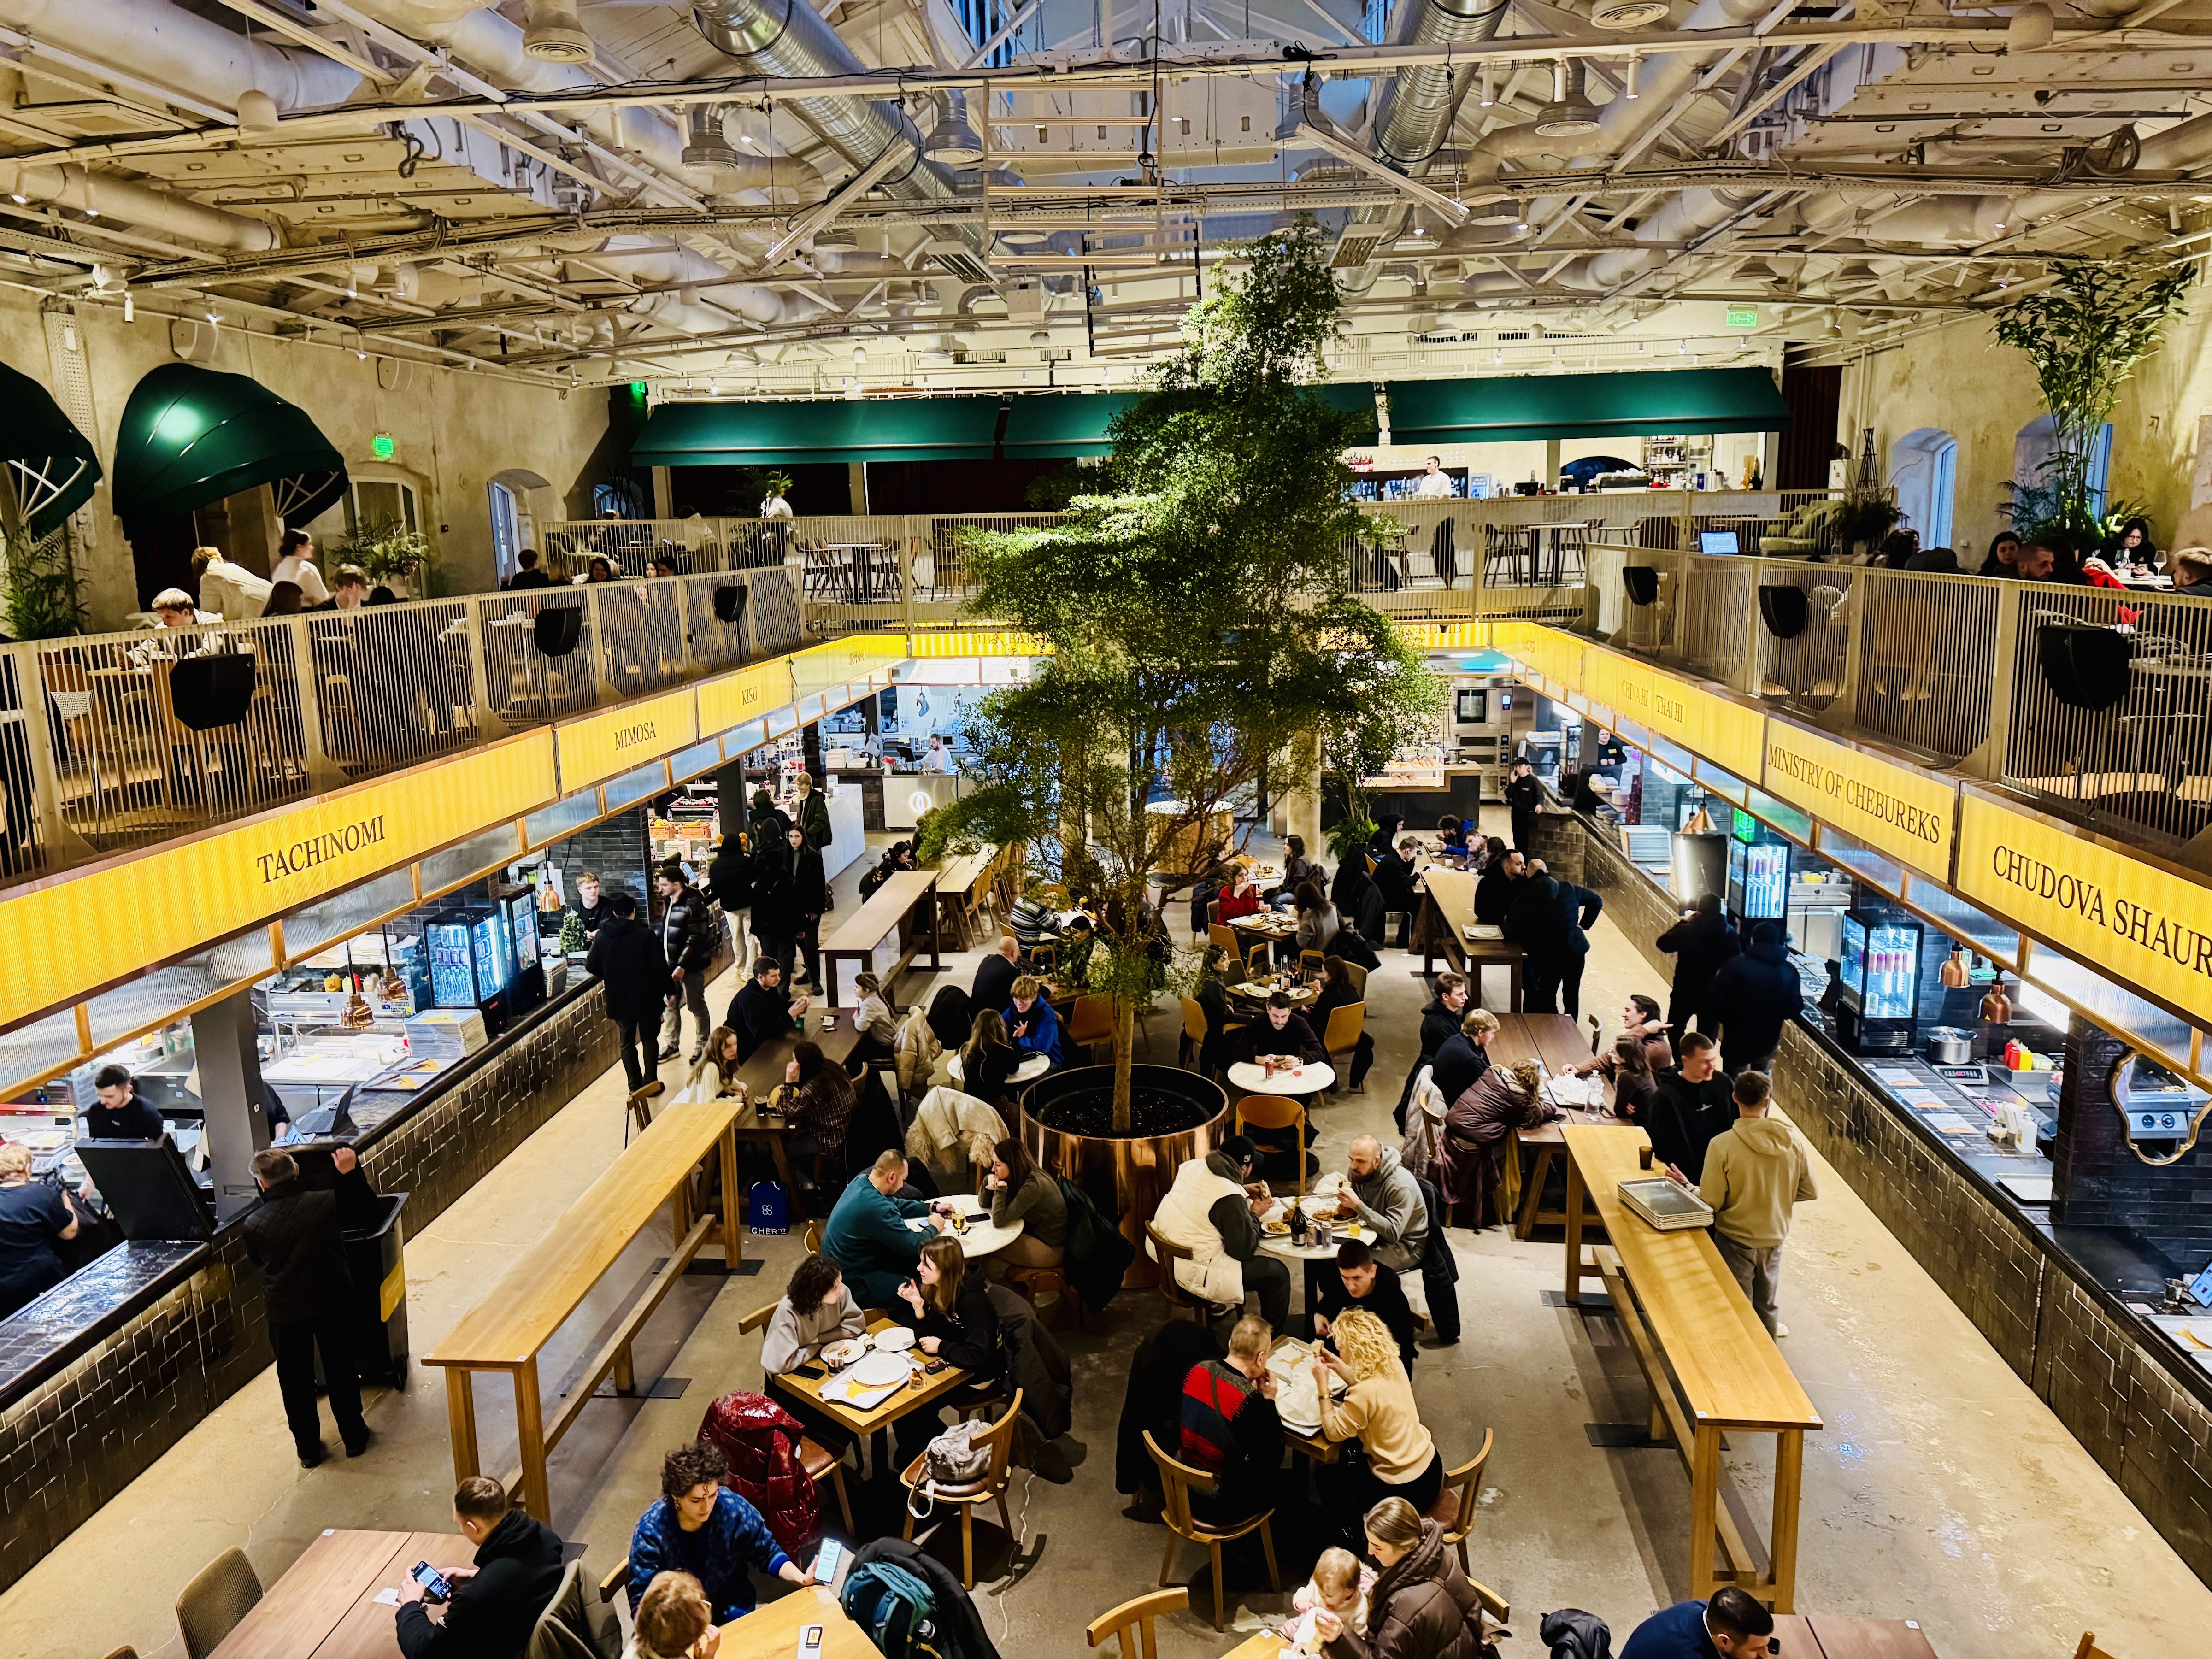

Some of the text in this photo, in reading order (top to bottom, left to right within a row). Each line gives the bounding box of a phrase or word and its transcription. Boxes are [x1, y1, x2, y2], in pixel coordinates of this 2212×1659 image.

[741, 686, 758, 705] KISU
[1622, 680, 1648, 707] CHINA HI
[1656, 695, 1683, 723] THAI HI
[614, 720, 656, 750] MIMOSA
[1768, 744, 1940, 844] MINISTRY OF CHEBUREKS
[257, 815, 385, 883] TACHINOMI
[1993, 845, 2212, 978] CHUDOVA SHAUR
